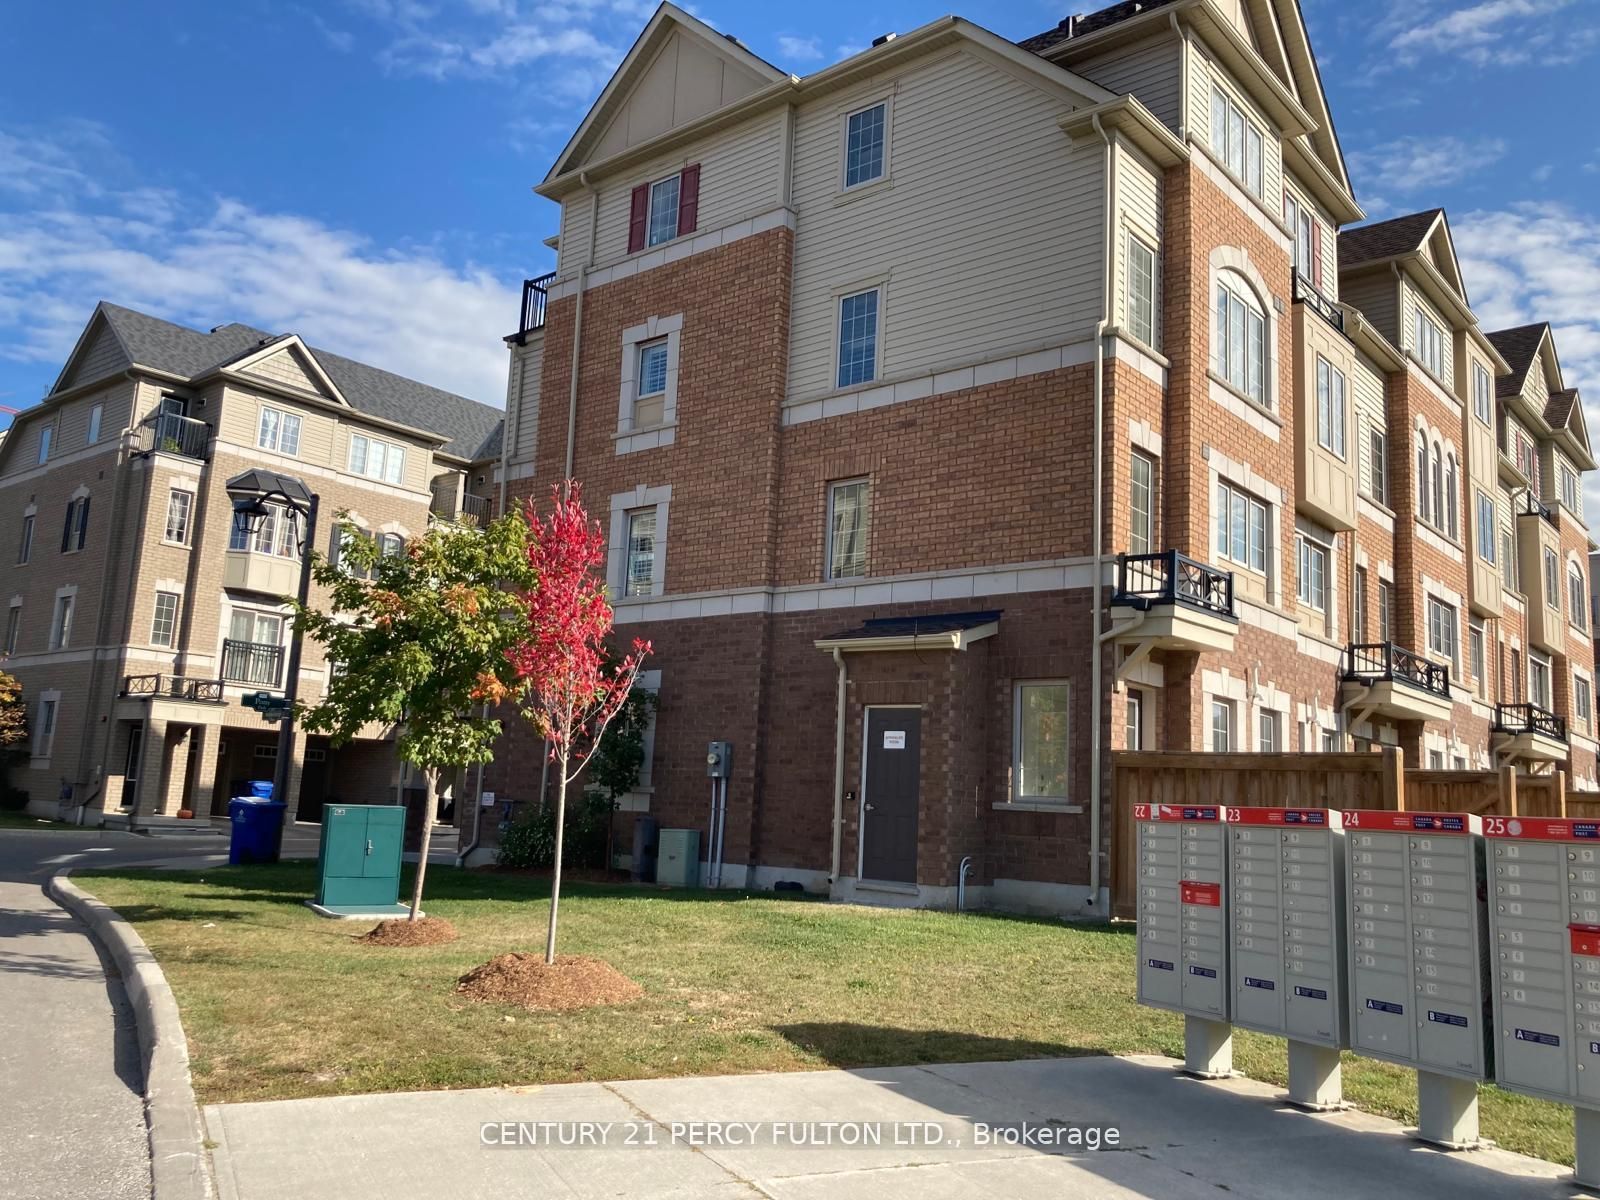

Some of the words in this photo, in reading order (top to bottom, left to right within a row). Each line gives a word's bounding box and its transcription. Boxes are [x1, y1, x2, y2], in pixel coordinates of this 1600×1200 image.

[1228, 808, 1240, 821] 23
[1344, 812, 1359, 826] 24
[1486, 818, 1505, 834] 25
[1367, 1000, 1373, 1008] A
[1429, 1011, 1435, 1020] B
[1516, 1030, 1524, 1039] A
[1592, 1043, 1598, 1053] B
